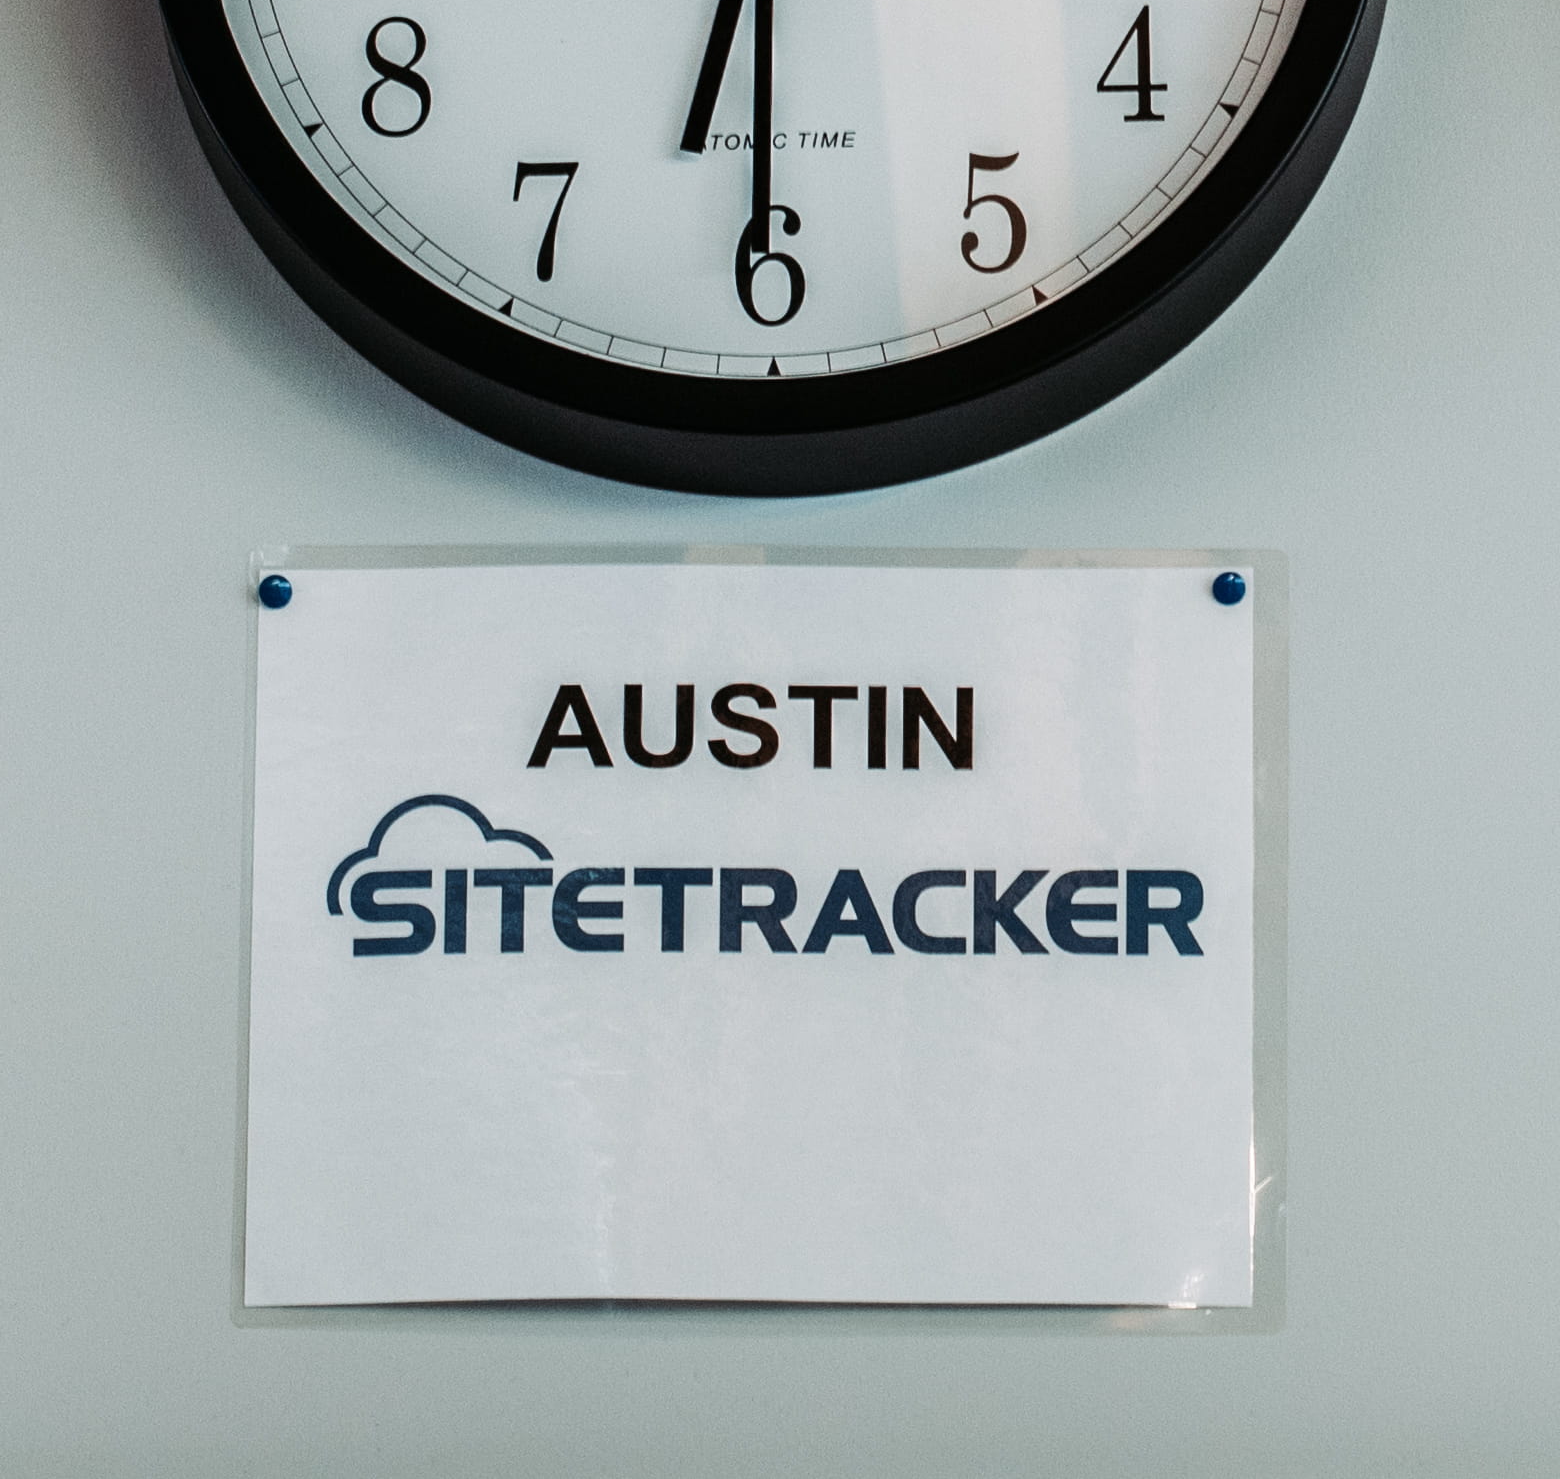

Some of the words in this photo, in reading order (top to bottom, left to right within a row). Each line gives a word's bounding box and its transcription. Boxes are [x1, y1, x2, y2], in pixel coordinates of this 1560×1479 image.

[362, 17, 431, 137] 8
[1097, 5, 1167, 122] 4
[690, 133, 787, 150] TOMC
[798, 132, 856, 148] TIME
[513, 162, 579, 282] 7
[735, 204, 805, 326] 6
[961, 153, 1026, 274] 5
[527, 683, 973, 770] AUSTIN
[348, 865, 1207, 958] SITETRACKER
